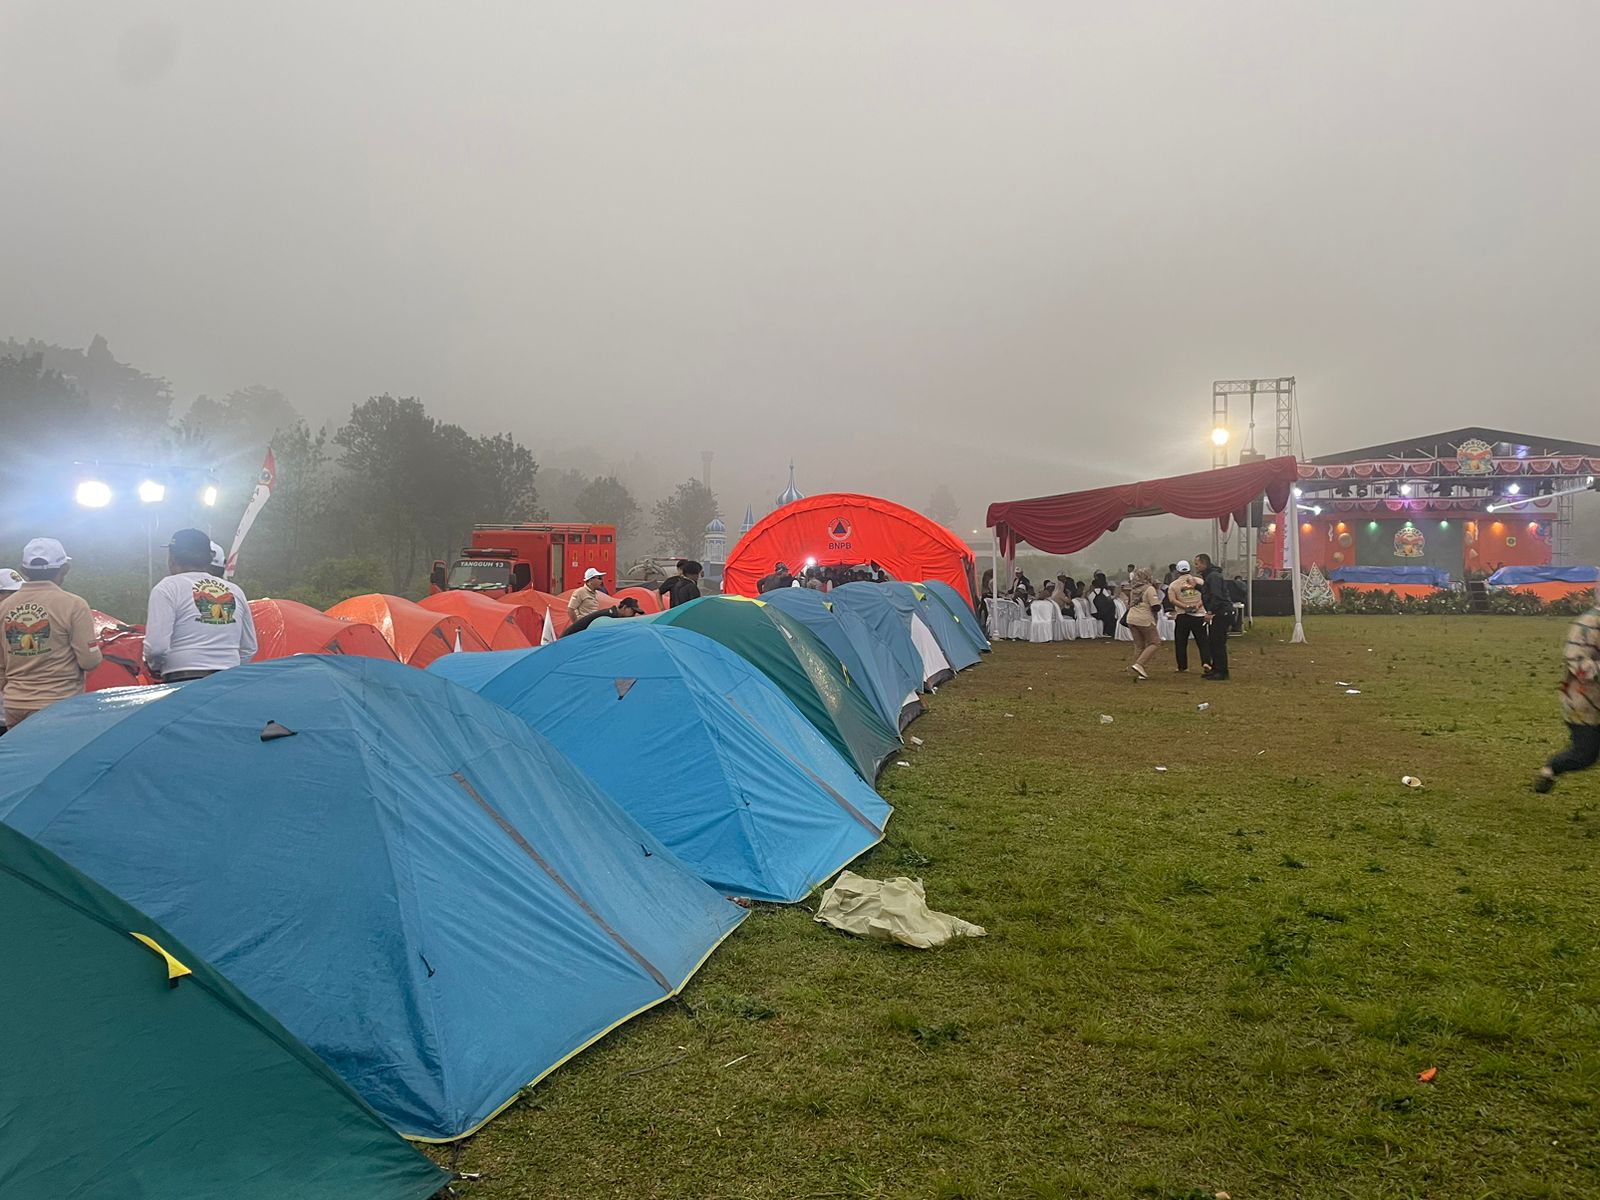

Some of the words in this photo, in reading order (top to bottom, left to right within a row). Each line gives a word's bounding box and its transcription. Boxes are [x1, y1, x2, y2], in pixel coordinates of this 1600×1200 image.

[828, 542, 852, 550] BNPB
[191, 578, 231, 592] JAMBORE
[5, 602, 48, 622] JAMBORE
